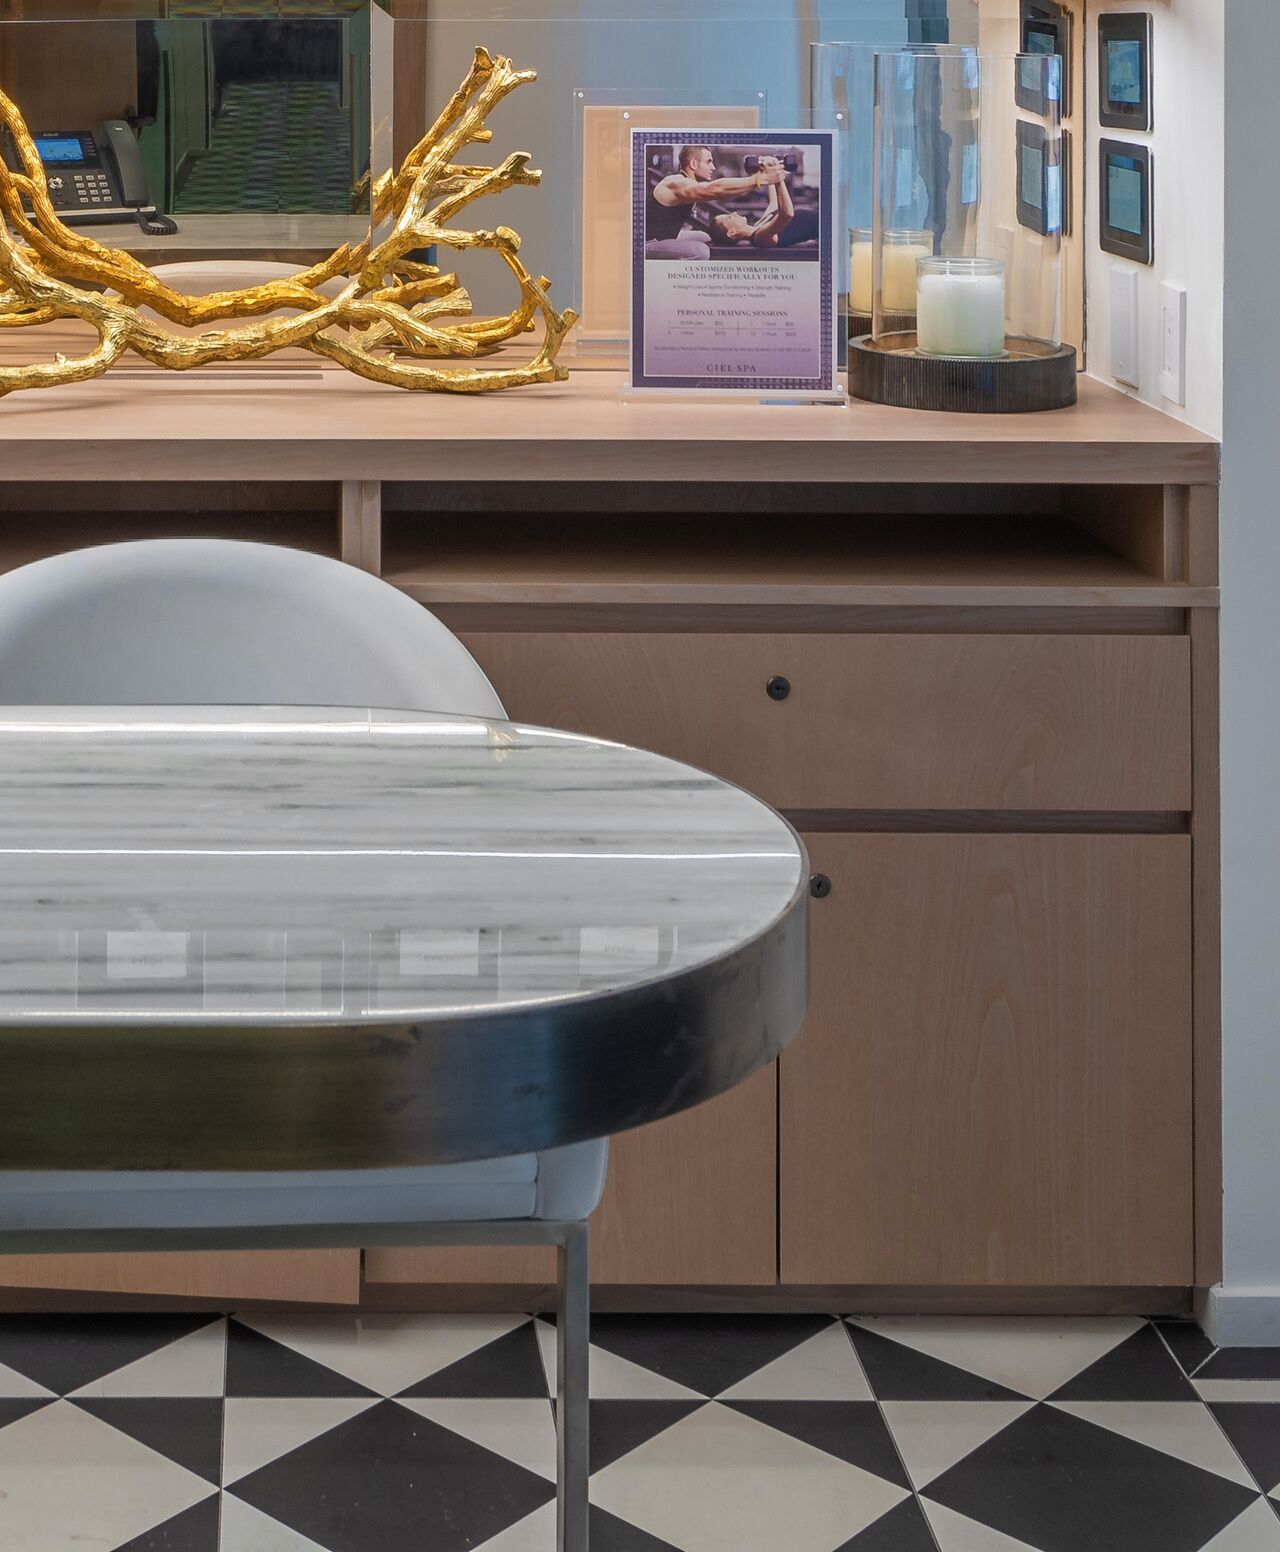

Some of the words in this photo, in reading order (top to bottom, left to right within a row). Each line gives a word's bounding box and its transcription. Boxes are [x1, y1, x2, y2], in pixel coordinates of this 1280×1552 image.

[717, 309, 751, 317] TRAINING
[706, 364, 734, 373] CIEL
[736, 364, 757, 373] SPA
